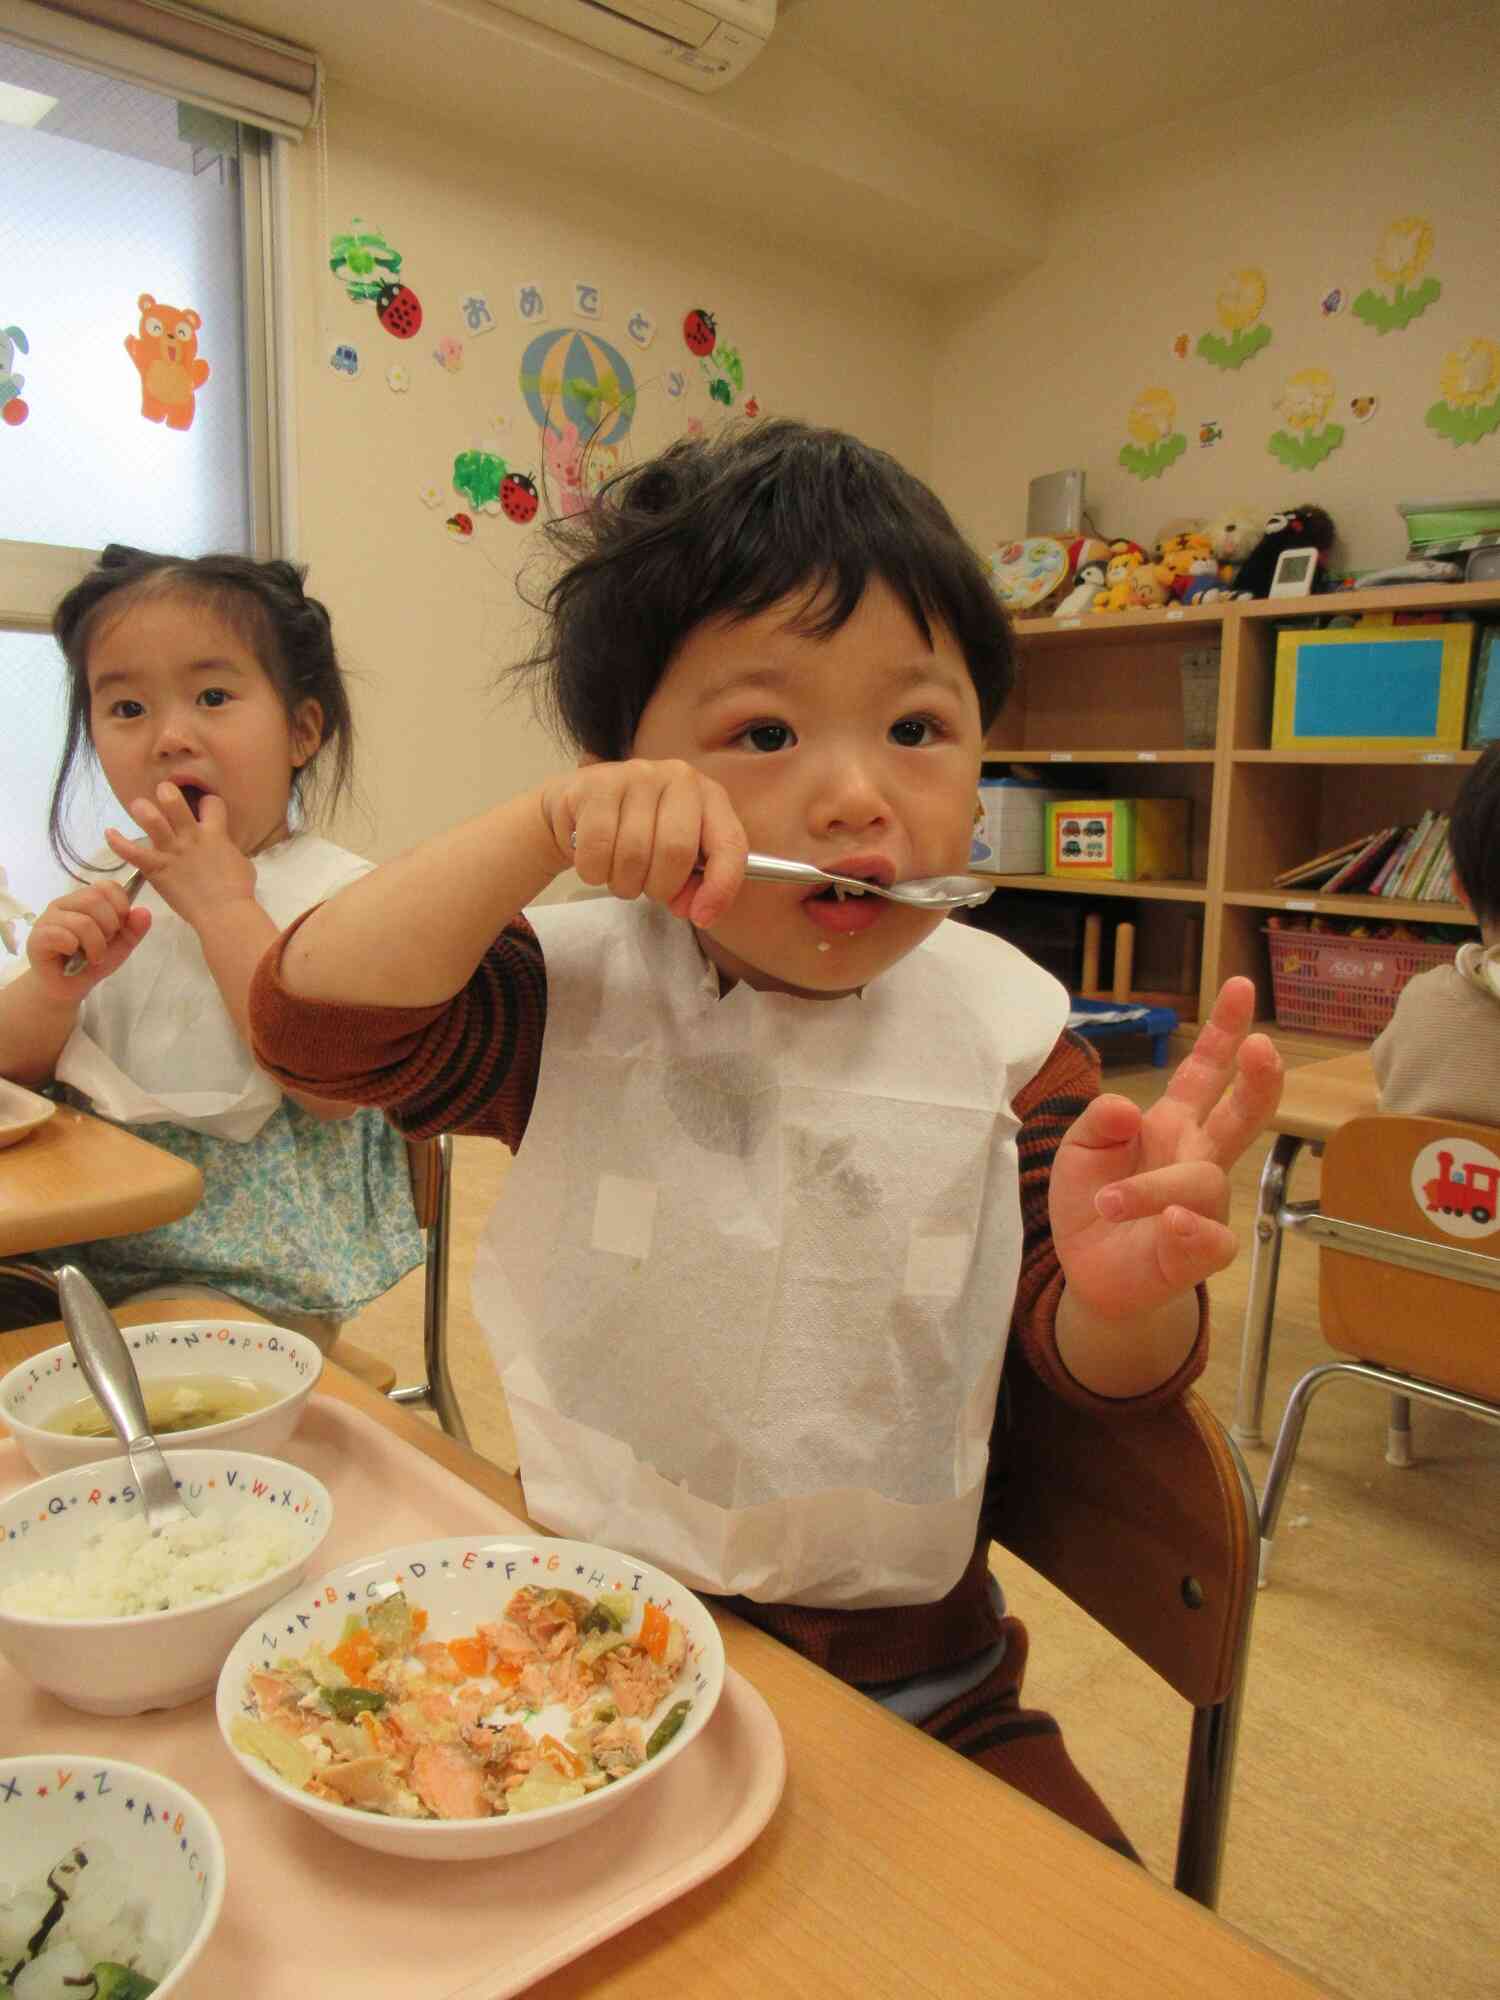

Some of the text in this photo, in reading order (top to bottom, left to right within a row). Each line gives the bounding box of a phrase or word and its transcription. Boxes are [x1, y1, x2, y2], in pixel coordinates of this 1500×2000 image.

[30, 1369, 39, 1382] I
[54, 1356, 63, 1372] J
[145, 1332, 159, 1344] M
[184, 1333, 199, 1347] N
[218, 1329, 230, 1341] O
[268, 1337, 280, 1351] Q
[21, 1521, 29, 1536] P
[49, 1497, 67, 1514] Q
[88, 1488, 101, 1504] R
[122, 1485, 135, 1502] S
[190, 1483, 203, 1498] U
[227, 1471, 237, 1486] V
[252, 1479, 269, 1497] W
[281, 1490, 292, 1506] X
[302, 1497, 312, 1512] Y
[262, 1633, 278, 1649] Z
[296, 1614, 311, 1629] A
[325, 1586, 338, 1603] B
[366, 1581, 378, 1597] C
[409, 1563, 426, 1578] D
[462, 1552, 478, 1570] E
[505, 1562, 517, 1580] F
[546, 1554, 561, 1570] G
[586, 1570, 605, 1588] H
[631, 1574, 643, 1591] I
[0, 1776, 22, 1801] X
[57, 1769, 72, 1791] Y
[93, 1771, 112, 1794] Z
[143, 1803, 155, 1824] A
